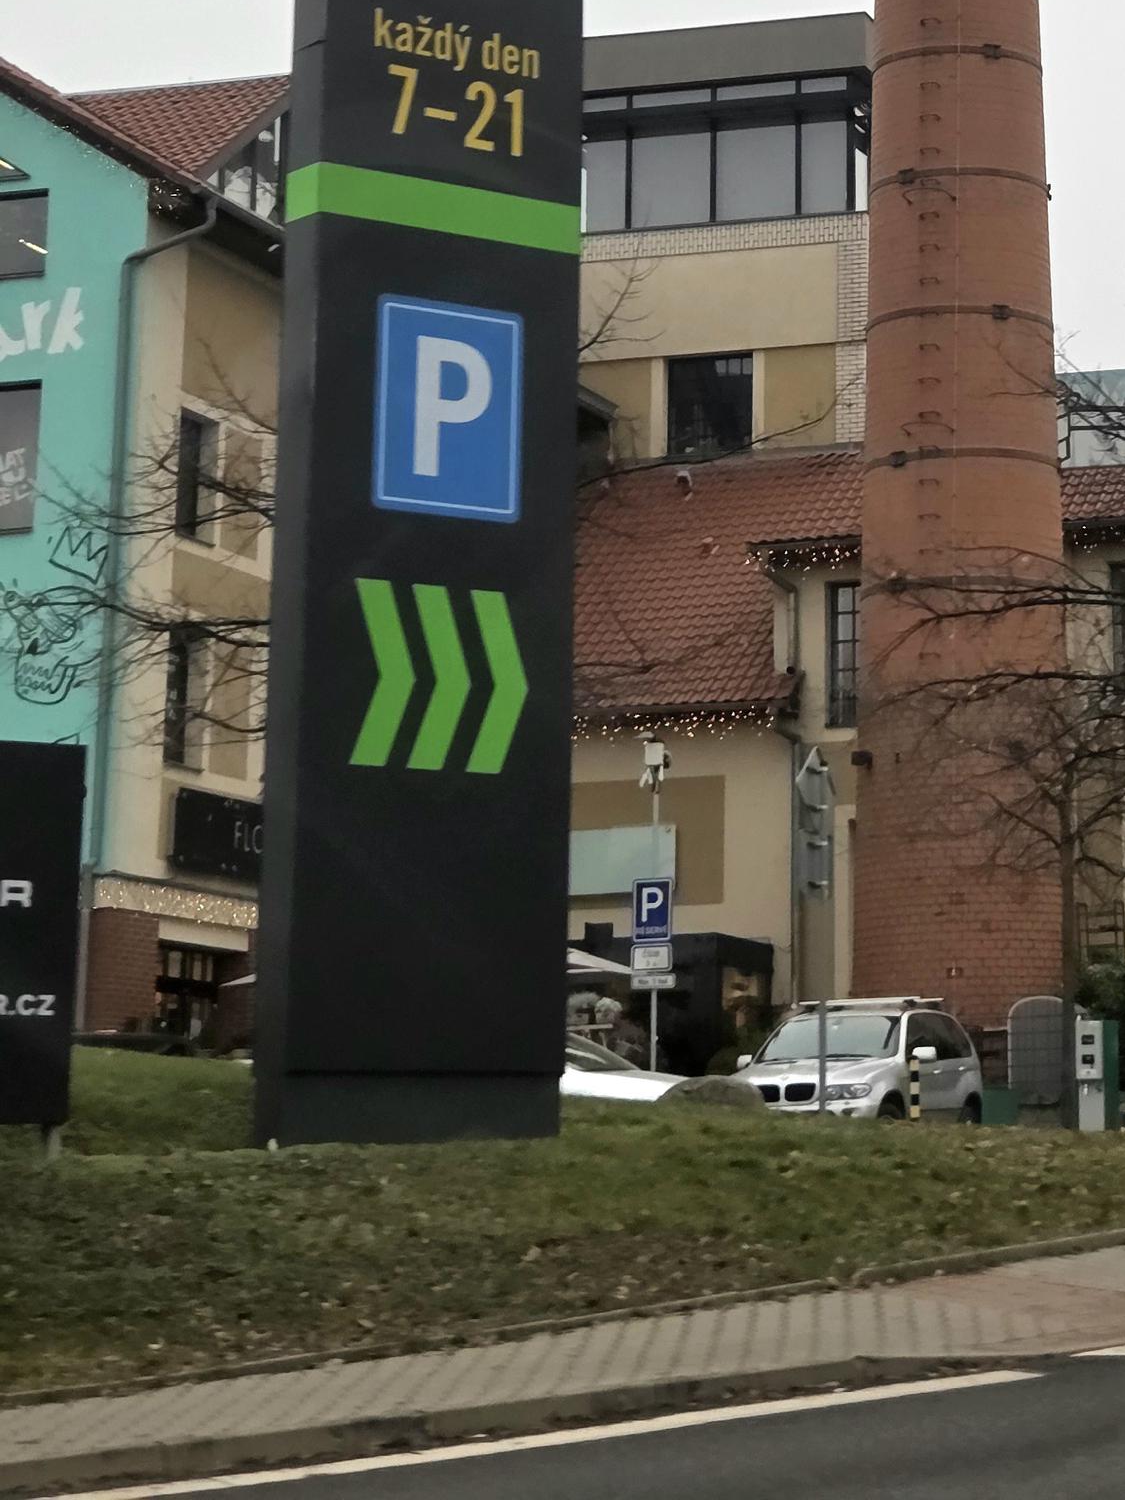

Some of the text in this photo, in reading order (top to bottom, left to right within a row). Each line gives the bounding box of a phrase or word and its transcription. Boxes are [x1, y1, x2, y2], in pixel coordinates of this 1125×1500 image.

[373, 7, 541, 80] každý den
[412, 334, 493, 477] P
[641, 887, 664, 922] P
